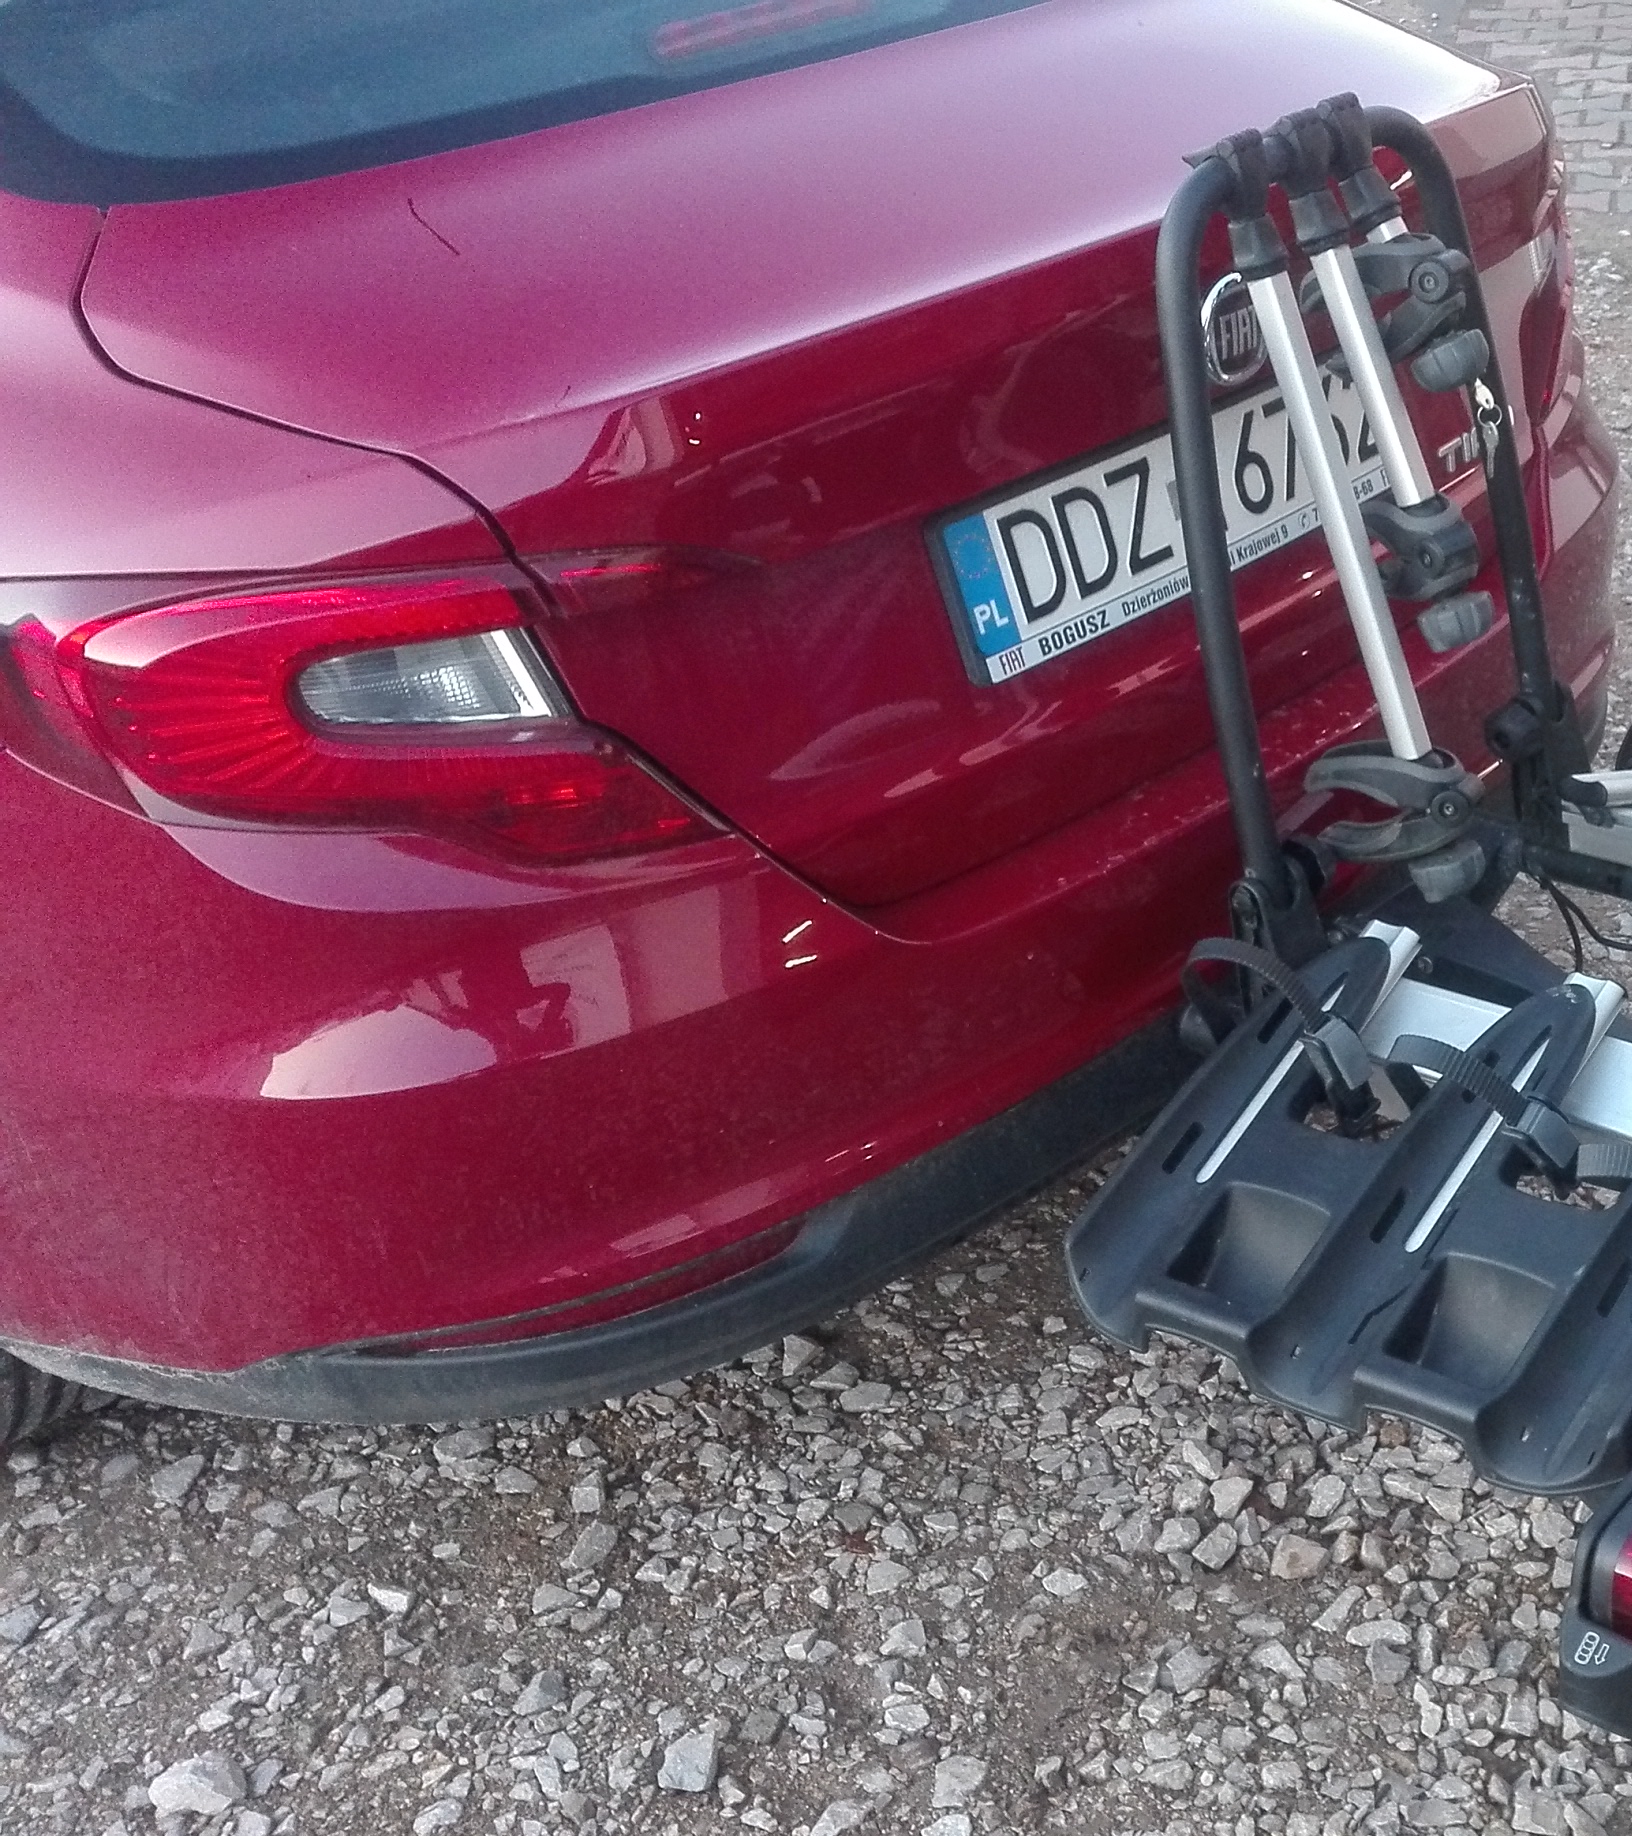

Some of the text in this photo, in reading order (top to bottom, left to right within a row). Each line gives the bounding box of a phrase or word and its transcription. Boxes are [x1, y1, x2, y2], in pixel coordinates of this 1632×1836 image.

[997, 457, 1174, 624] DDZ
[999, 646, 1026, 676] FIAT
[1038, 610, 1110, 657] BOGUSZ
[1121, 575, 1190, 617] Dzierżoniów
[1236, 527, 1281, 563] Krajowej
[1281, 524, 1289, 539] 9
[973, 599, 1009, 635] PL
